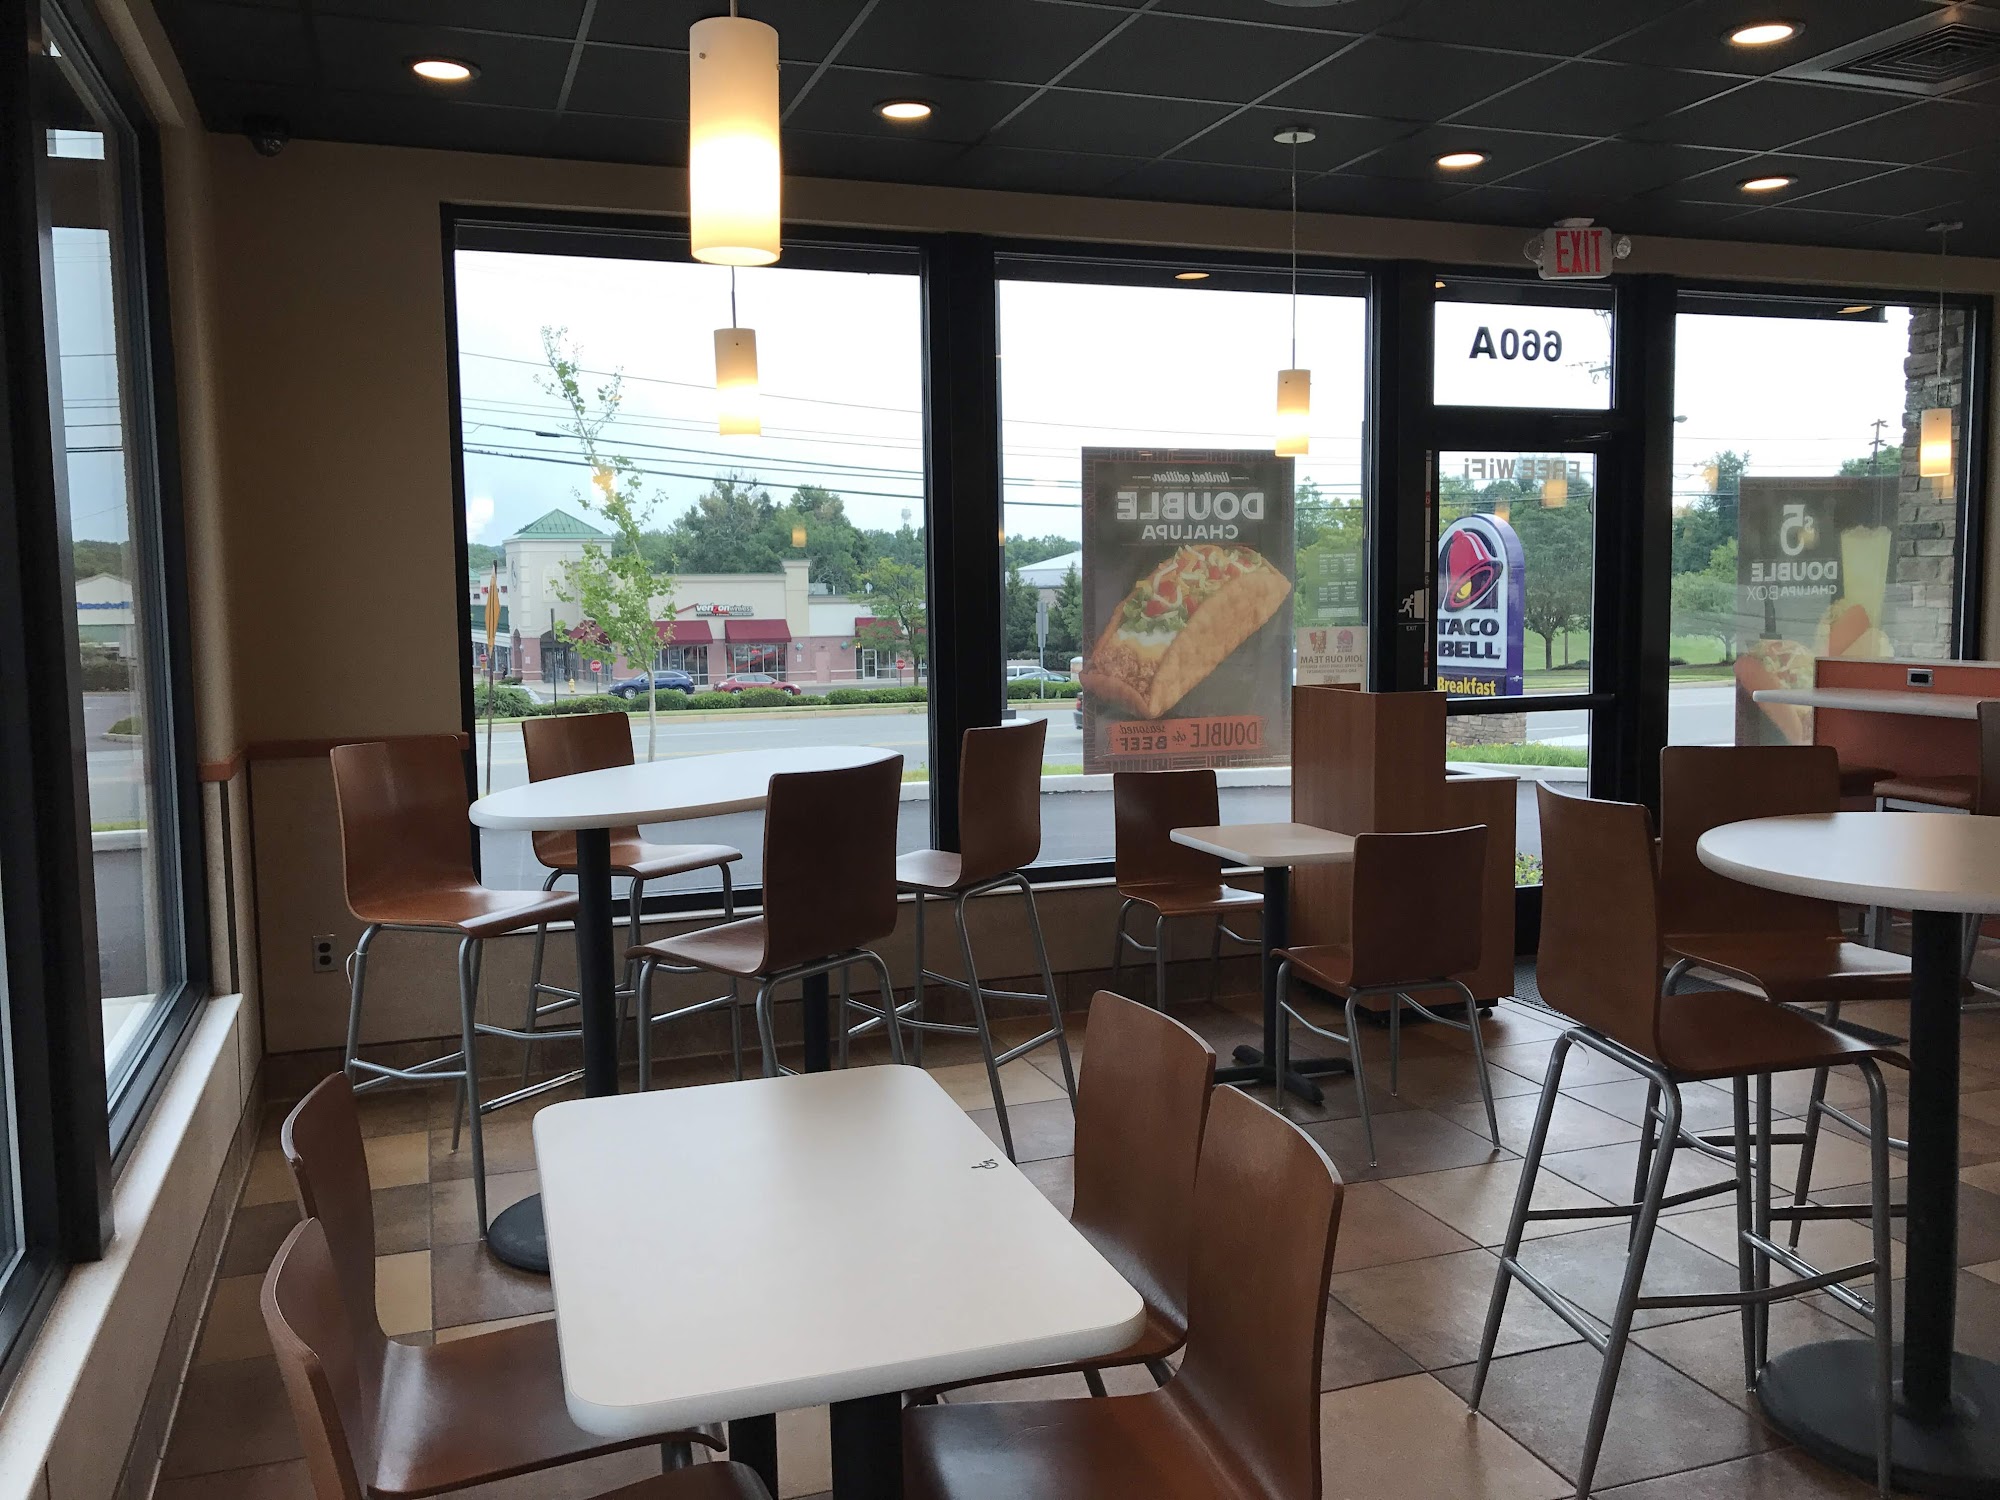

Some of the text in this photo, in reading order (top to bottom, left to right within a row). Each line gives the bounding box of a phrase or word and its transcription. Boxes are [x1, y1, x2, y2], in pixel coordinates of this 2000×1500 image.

[1555, 230, 1603, 274] EXIT
[696, 604, 729, 614] verizon
[1437, 618, 1500, 636] TACO
[1438, 640, 1501, 659] BELL
[1437, 676, 1496, 696] Breakfast
